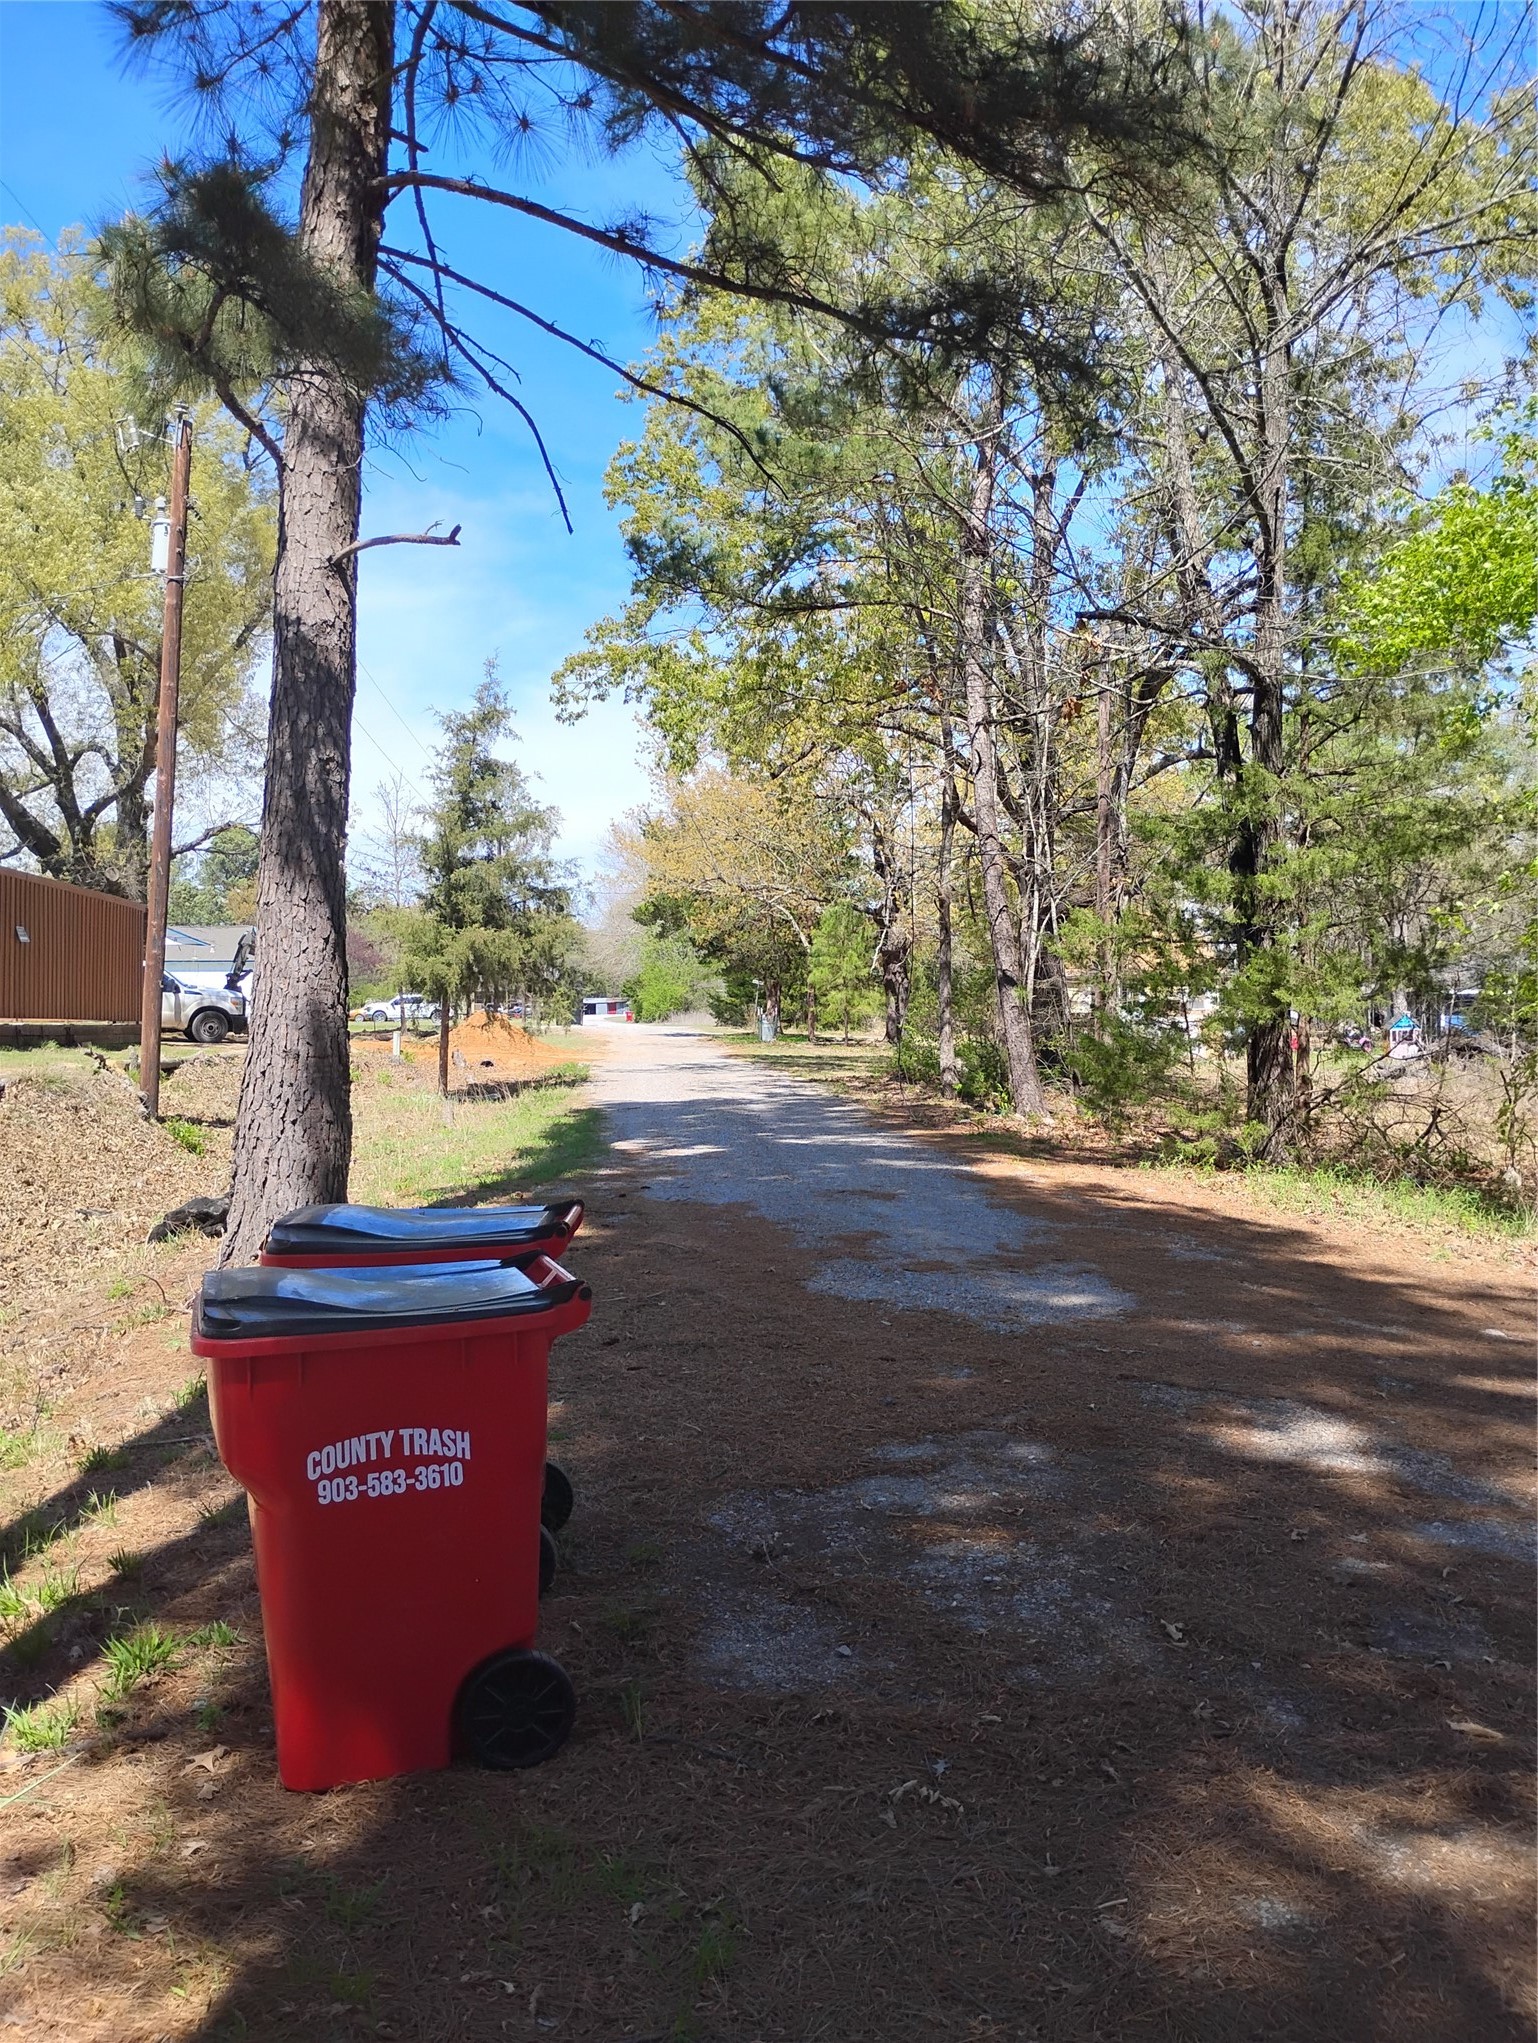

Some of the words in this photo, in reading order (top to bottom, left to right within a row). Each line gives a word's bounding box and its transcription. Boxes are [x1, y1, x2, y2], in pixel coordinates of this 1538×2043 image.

[306, 1429, 395, 1481] COUNTY
[398, 1427, 471, 1460] TRASH
[317, 1461, 464, 1505] 903-583-3610
